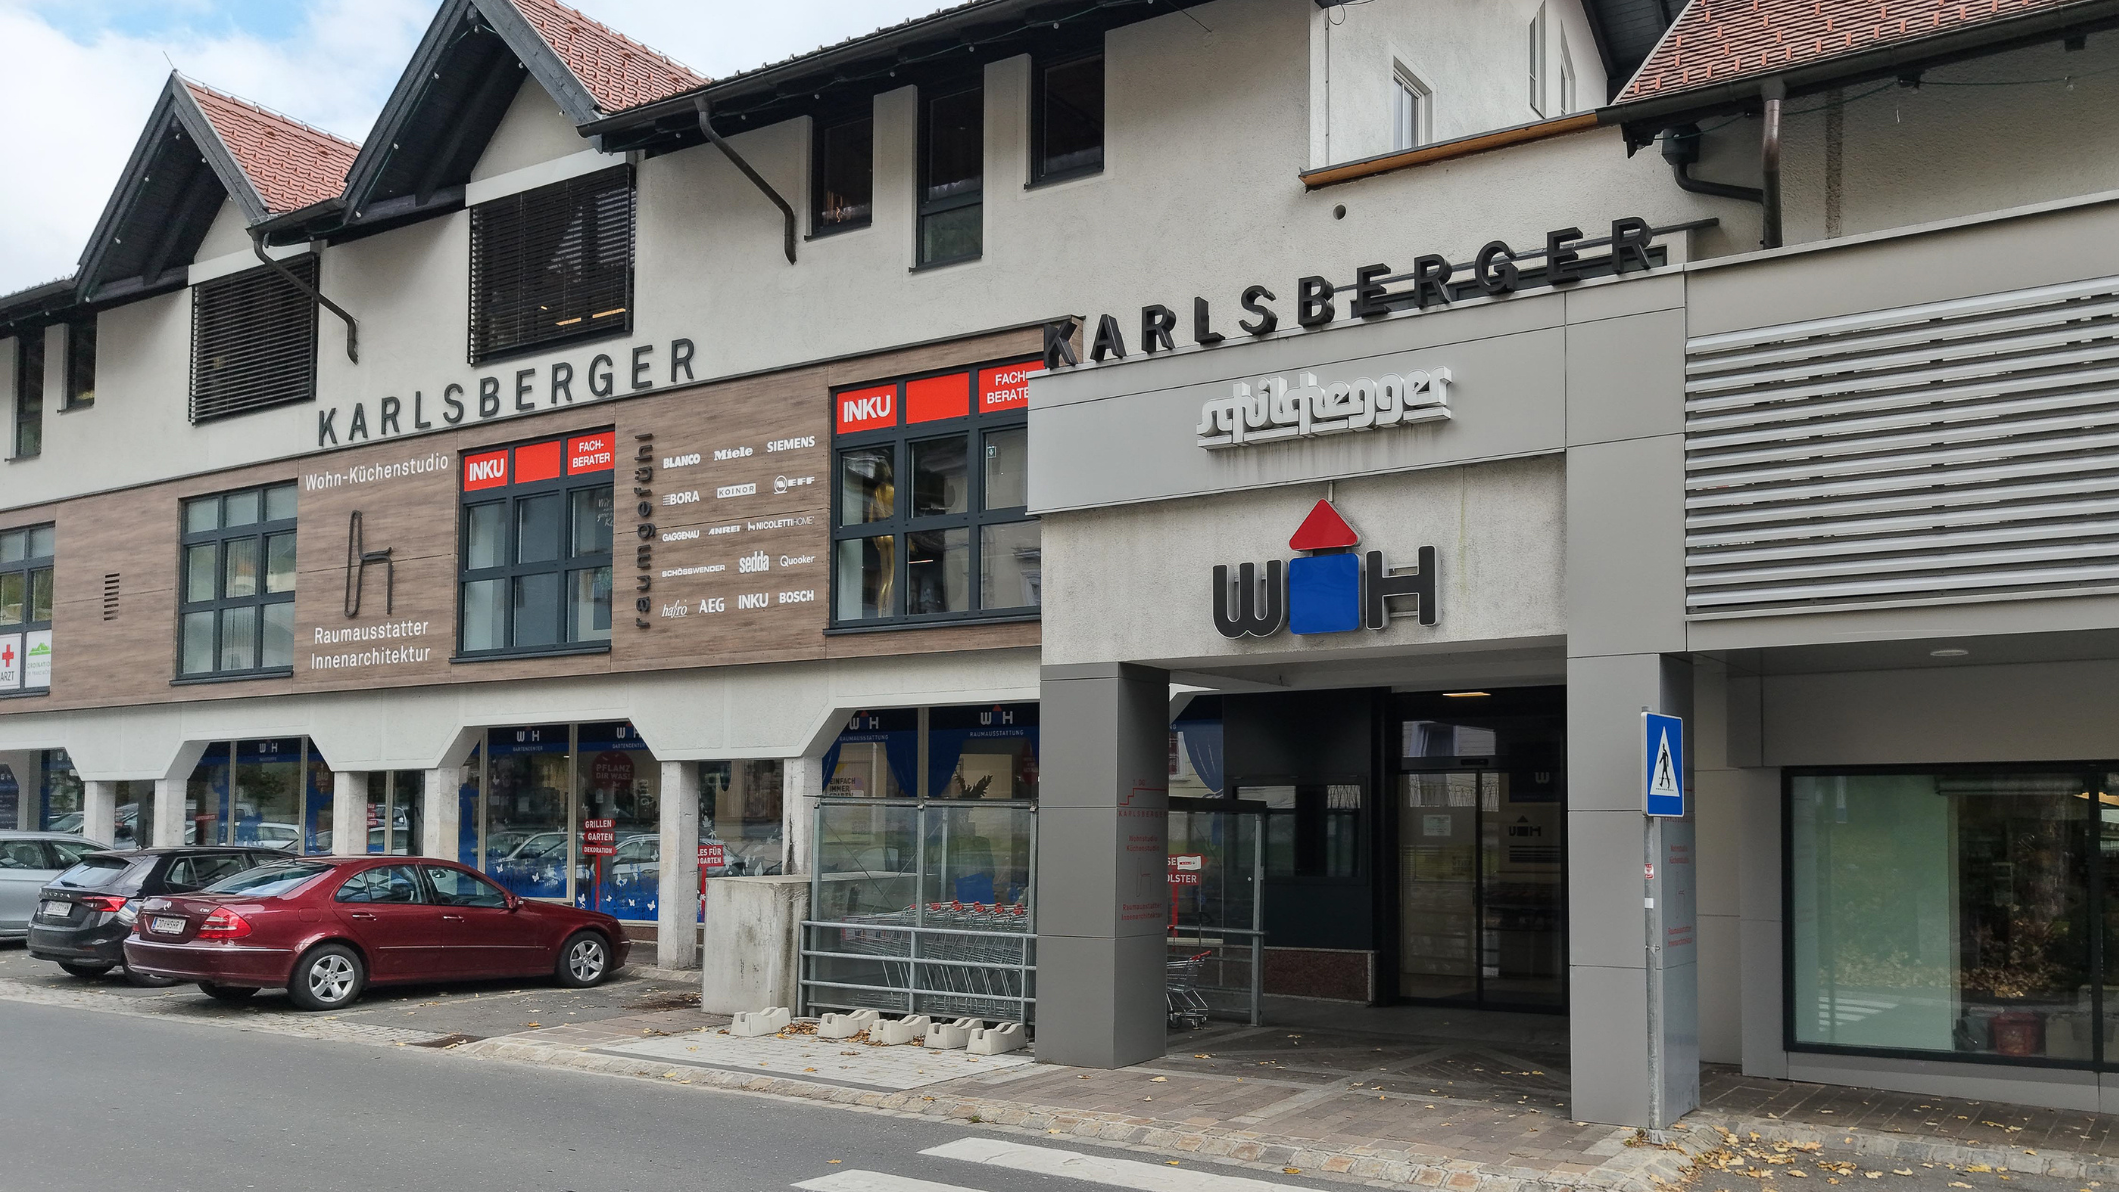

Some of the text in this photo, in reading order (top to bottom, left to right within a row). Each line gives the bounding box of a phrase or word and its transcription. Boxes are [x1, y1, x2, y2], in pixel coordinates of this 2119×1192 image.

[1042, 216, 1654, 371] KARLSBERGER
[318, 338, 694, 447] KARLSBERGER
[843, 394, 891, 424] INKU
[579, 439, 604, 453] FACH-
[766, 436, 815, 453] SIEMENS
[572, 452, 611, 468] BERATER
[663, 453, 701, 469] BLANCO
[713, 446, 753, 461] Miele
[305, 452, 449, 491] Wohn-Küchenstudio
[469, 458, 505, 482] INKU
[669, 490, 700, 506] BORA
[718, 485, 755, 497] KOINOR
[662, 530, 700, 542] GAGGENAU
[739, 551, 770, 573] sedda
[780, 555, 815, 567] Quooker
[738, 592, 769, 610] INKU
[779, 589, 815, 604] BOSCH
[699, 597, 725, 614] AEG
[314, 619, 429, 645] Raumausstatter
[310, 646, 431, 670] Innenarchitektur
[970, 729, 1024, 737] RAUMAUSSTATTUNG
[596, 763, 631, 772] PFLANZ
[829, 777, 856, 785] EINFACH
[584, 819, 612, 829] GRILLEN
[587, 832, 613, 841] GARTEN
[583, 846, 612, 854] DEKORATION
[709, 846, 721, 856] FÜR
[700, 857, 722, 865] GARTEN
